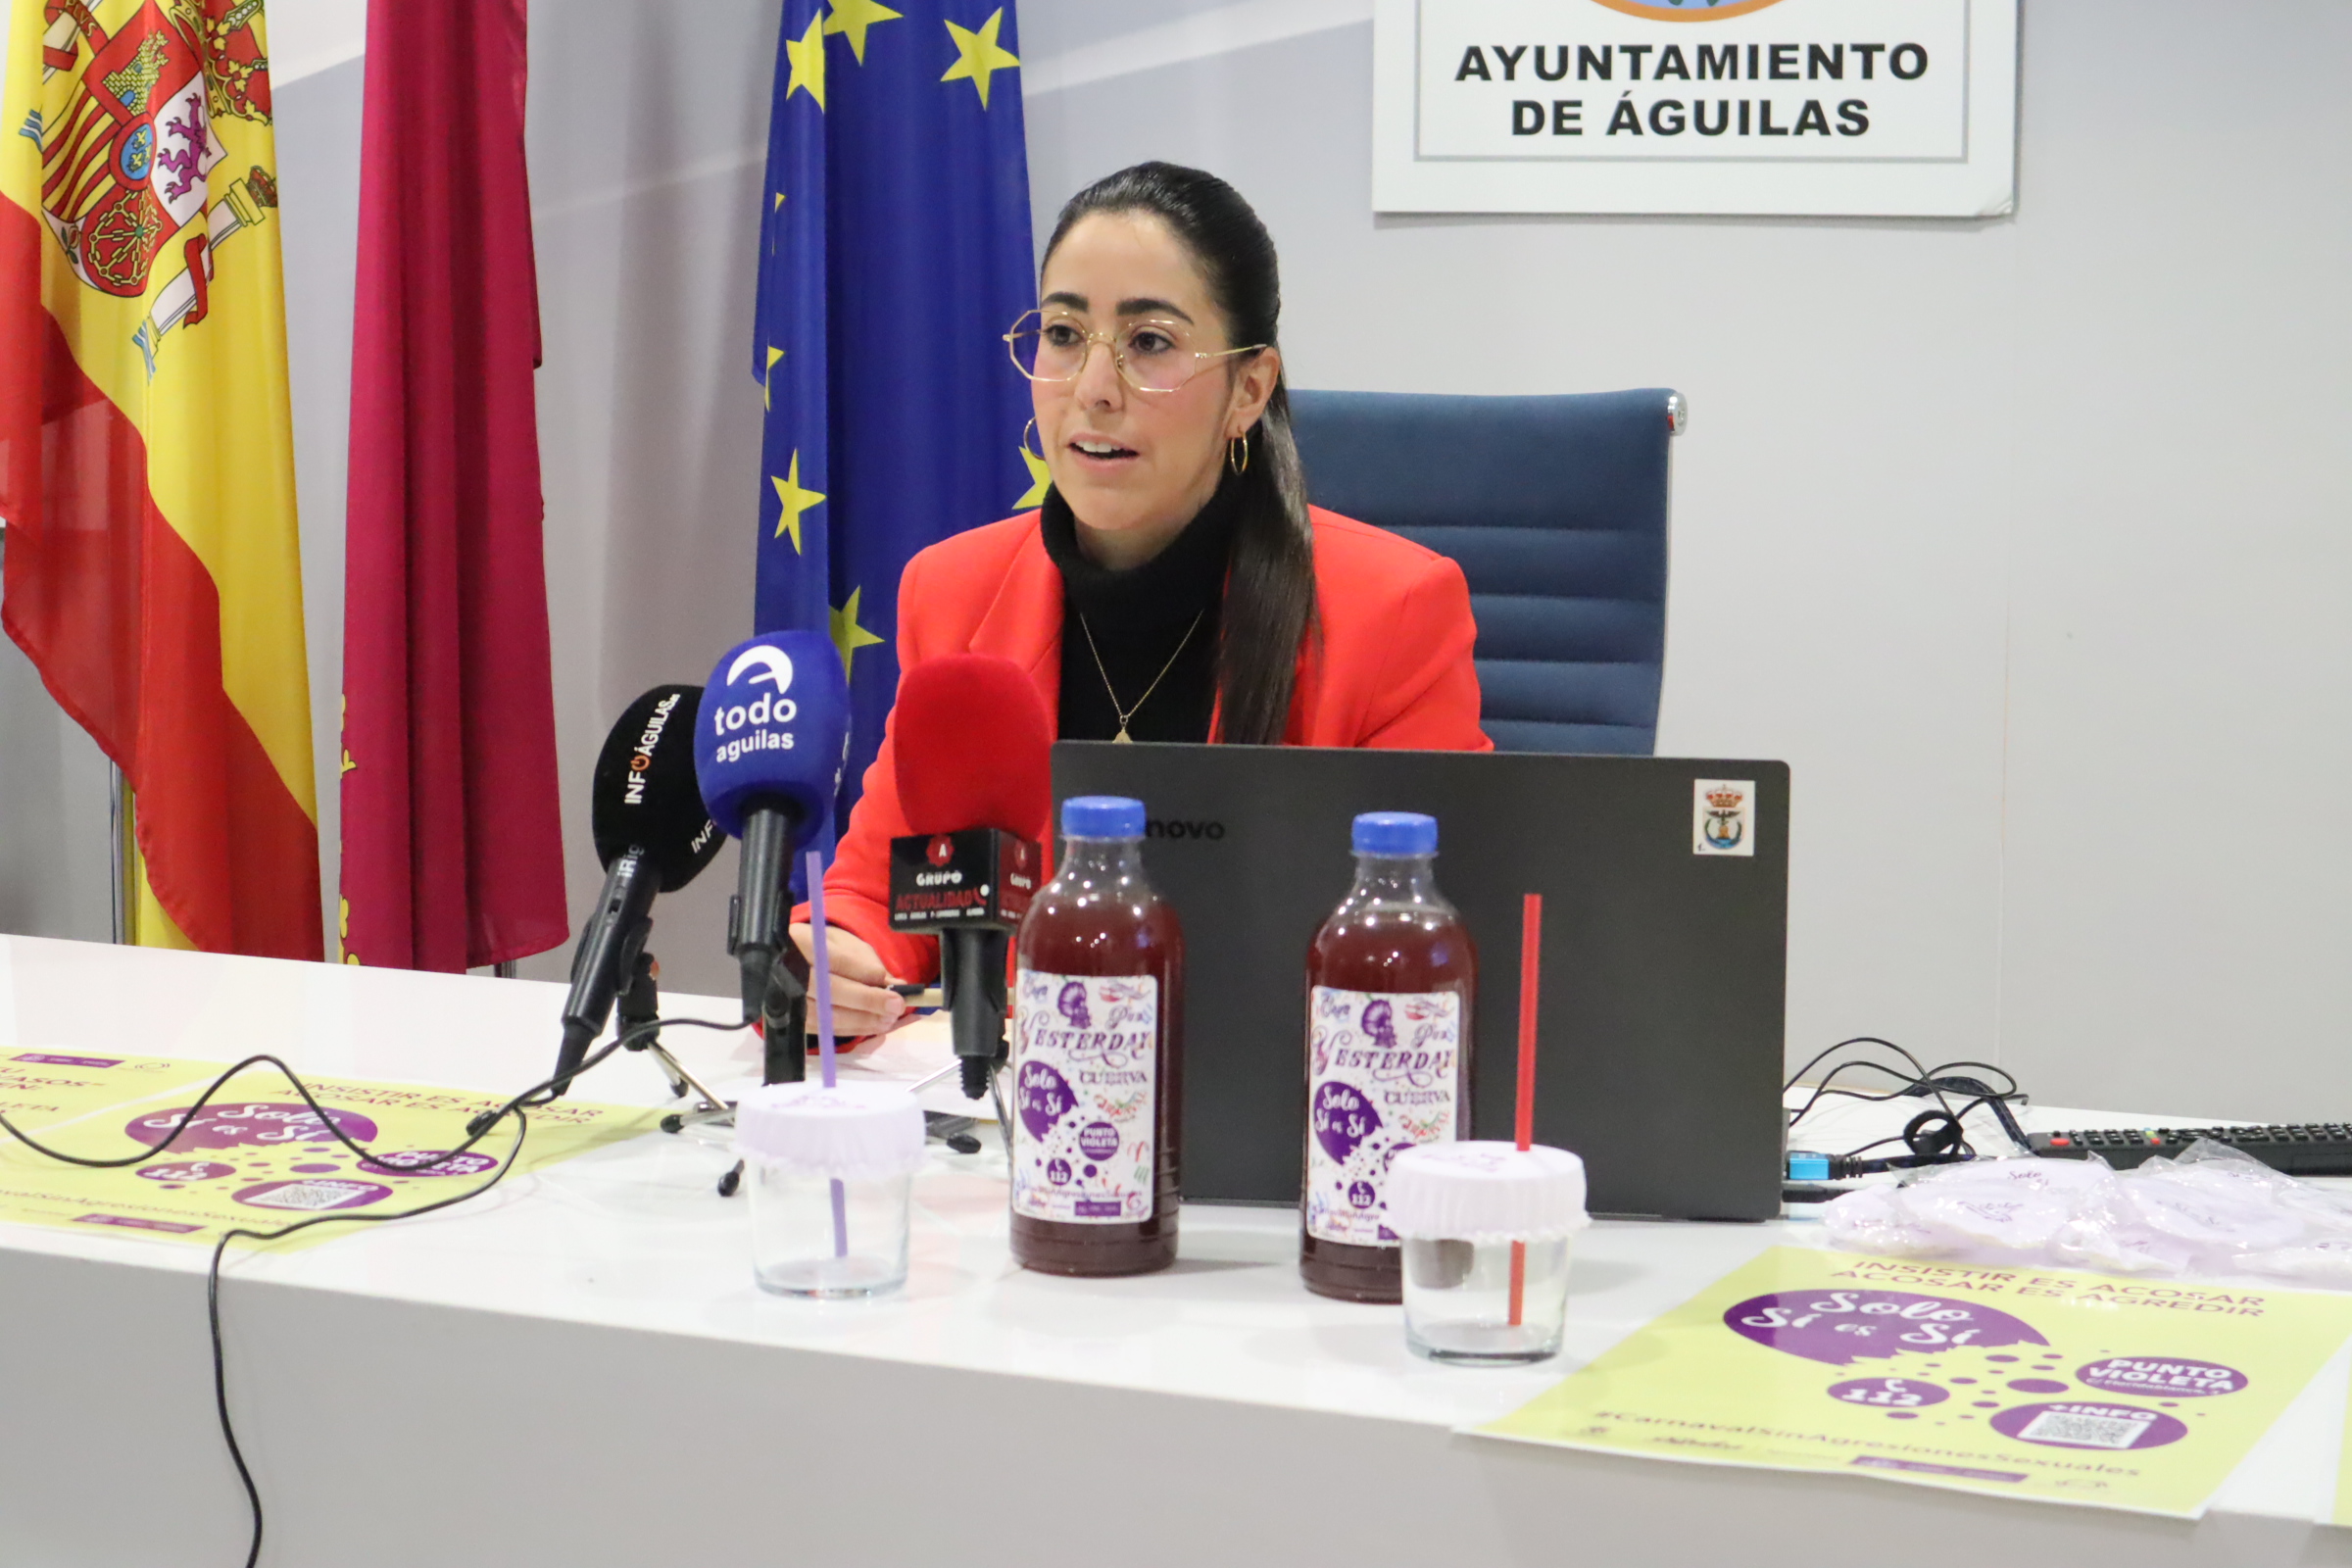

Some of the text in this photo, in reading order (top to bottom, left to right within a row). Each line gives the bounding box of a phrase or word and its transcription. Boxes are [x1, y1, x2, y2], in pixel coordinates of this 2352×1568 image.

[1455, 43, 1929, 81] AYUNTAMIENTO
[1511, 90, 1871, 137] DE ÁGUILAS
[714, 692, 797, 736] todo
[715, 729, 795, 762] aguilas
[690, 818, 716, 854] INF
[1144, 819, 1225, 841] novo
[915, 870, 963, 887] GRUPO
[1016, 1005, 1151, 1060] YESTERDAY
[1311, 1025, 1452, 1083] YESTERDAY
[1024, 1064, 1057, 1090] Solo
[303, 1083, 422, 1100] INSISTIR
[1323, 1085, 1360, 1111] Solo
[218, 1103, 341, 1125] Solo
[1080, 1136, 1118, 1148] VIOLETA
[1830, 1269, 2265, 1317] ACOSAR ES AGREDIR
[1853, 1261, 2265, 1306] INSISTIR ES ACOSAR
[1809, 1292, 1975, 1321] Solo
[1834, 1323, 1879, 1337] es
[2088, 1366, 2235, 1391] VIOLETA
[2107, 1358, 2232, 1379] PUNTO
[1840, 1387, 1924, 1406] 112
[2047, 1403, 2158, 1421] +INFO
[1594, 1411, 2140, 1476] #CarnavalSinAgresionesSexuales
